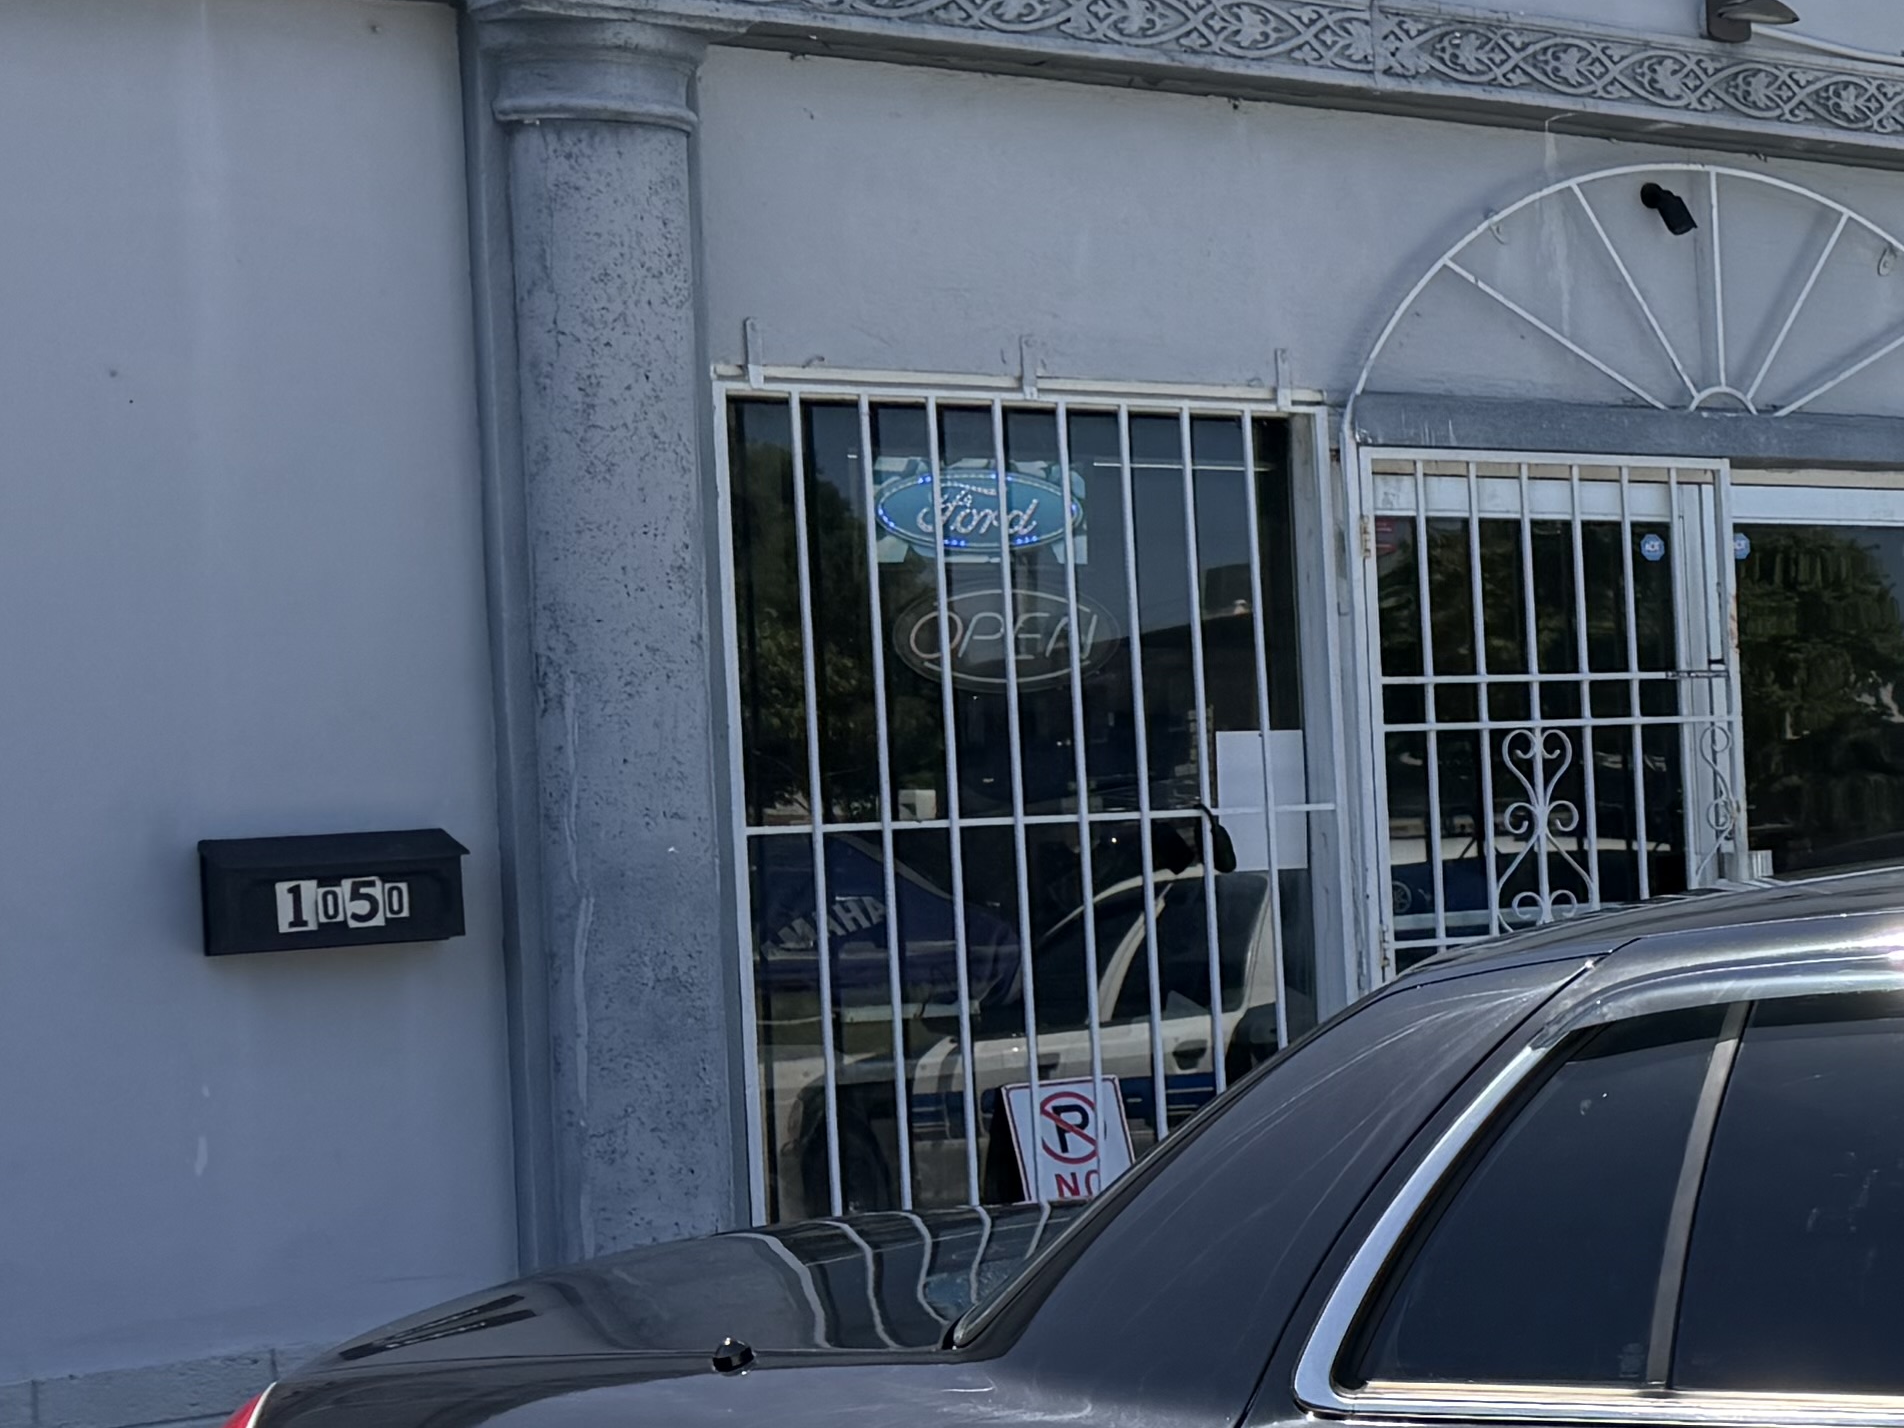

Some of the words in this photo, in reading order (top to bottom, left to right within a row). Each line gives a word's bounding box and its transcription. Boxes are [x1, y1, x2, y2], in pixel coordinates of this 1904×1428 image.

[916, 490, 1040, 534] Ford
[910, 612, 1098, 660] OPEN
[286, 879, 404, 929] 1050
